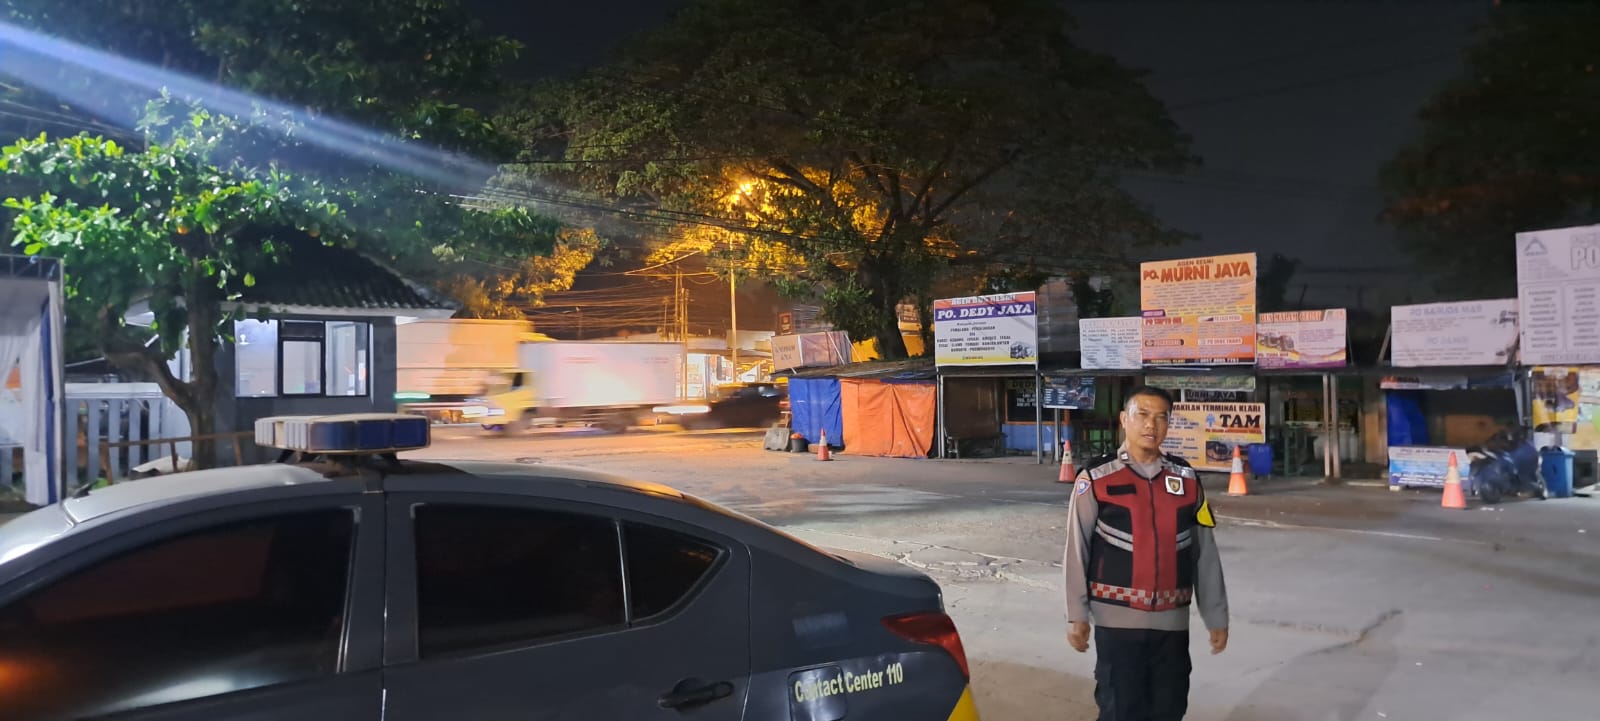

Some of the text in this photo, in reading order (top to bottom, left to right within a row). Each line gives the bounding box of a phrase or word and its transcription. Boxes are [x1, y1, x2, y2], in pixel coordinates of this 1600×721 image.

[1160, 264, 1210, 283] MURNI
[1214, 261, 1251, 279] JAYA
[937, 303, 1032, 320] PO. DEDY JAYA
[1202, 404, 1237, 412] TERMINAL
[1220, 414, 1261, 428] TAM
[794, 662, 904, 703] Contact Center 110
